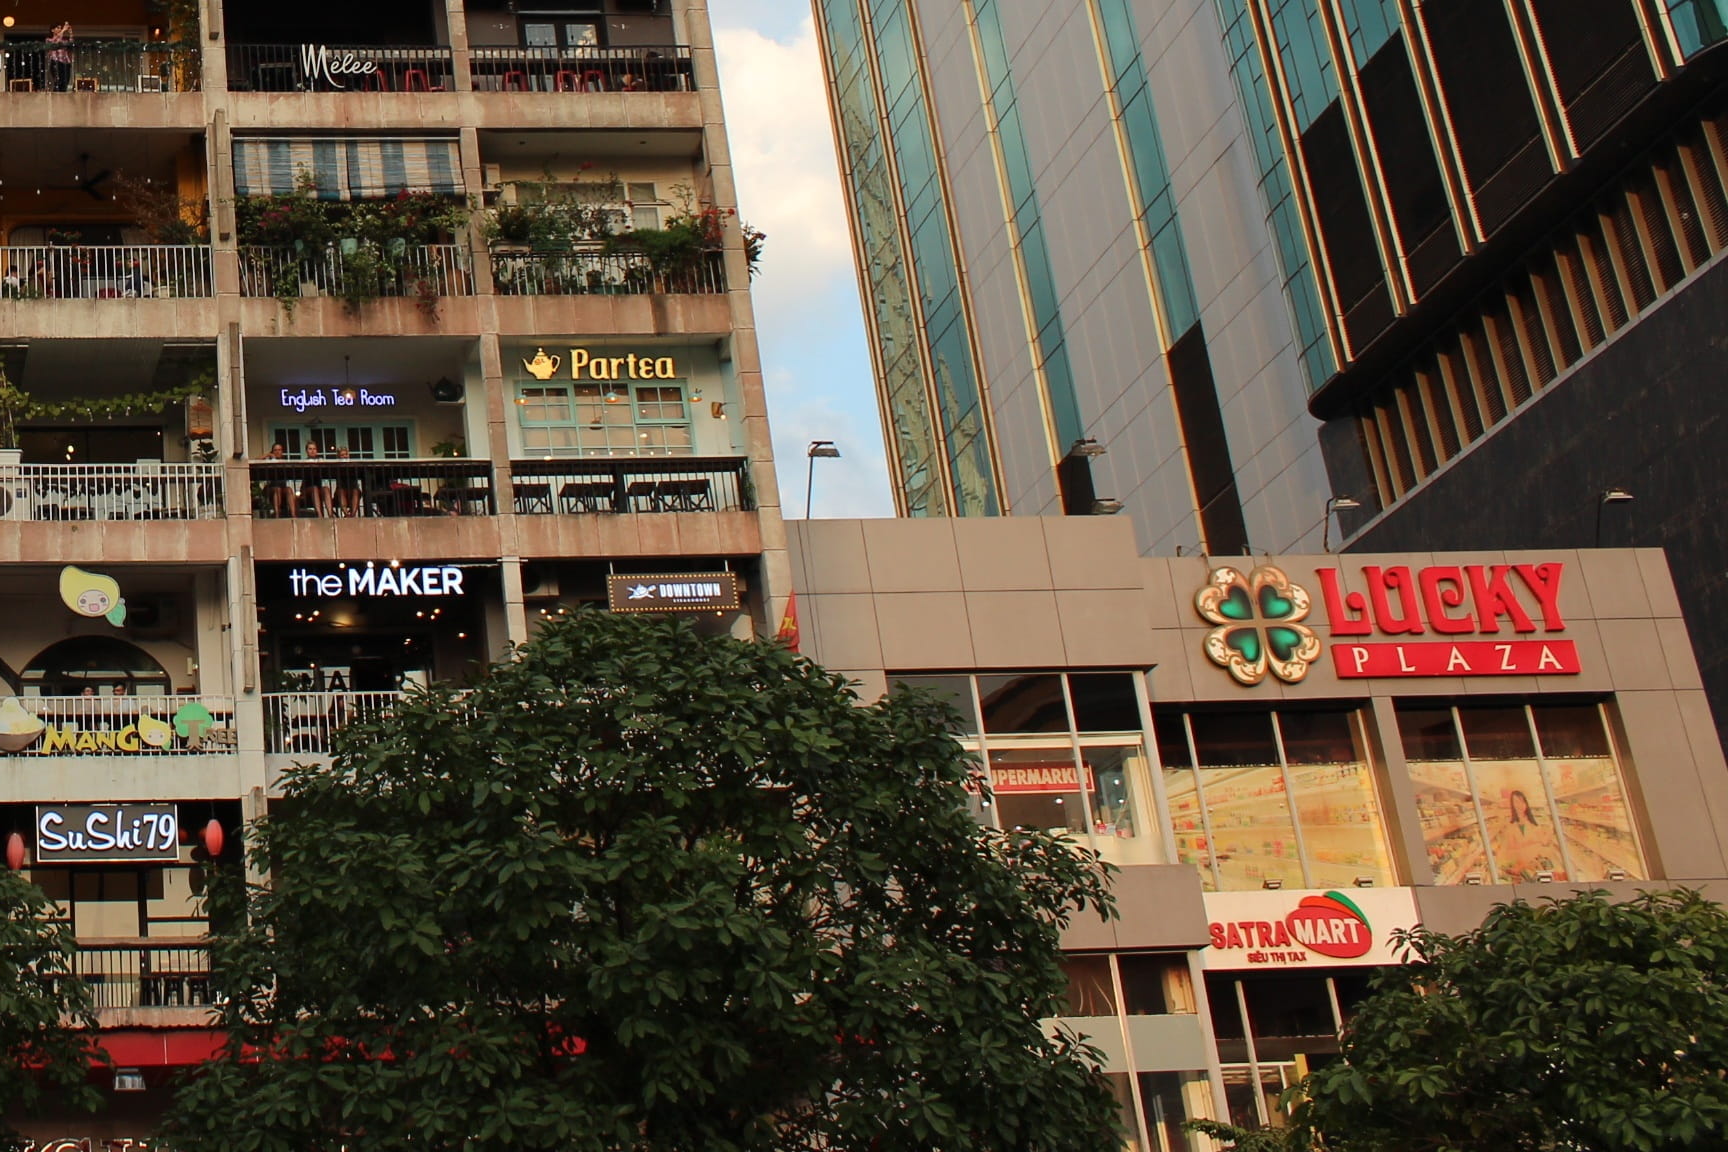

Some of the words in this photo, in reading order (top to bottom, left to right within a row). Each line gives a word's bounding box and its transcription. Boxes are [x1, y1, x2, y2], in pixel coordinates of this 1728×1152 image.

[301, 43, 378, 88] Mêlee
[570, 348, 676, 380] Partea
[281, 389, 327, 412] English
[331, 389, 354, 406] Tea
[360, 389, 394, 406] Room
[289, 568, 343, 597] the
[348, 567, 465, 597] MAKER
[659, 583, 721, 598] DOWNTOWN
[1315, 562, 1566, 637] LUCKY
[1355, 644, 1564, 673] PLAZA
[991, 767, 1089, 786] UPERMARKT
[1288, 951, 1306, 962] TAX
